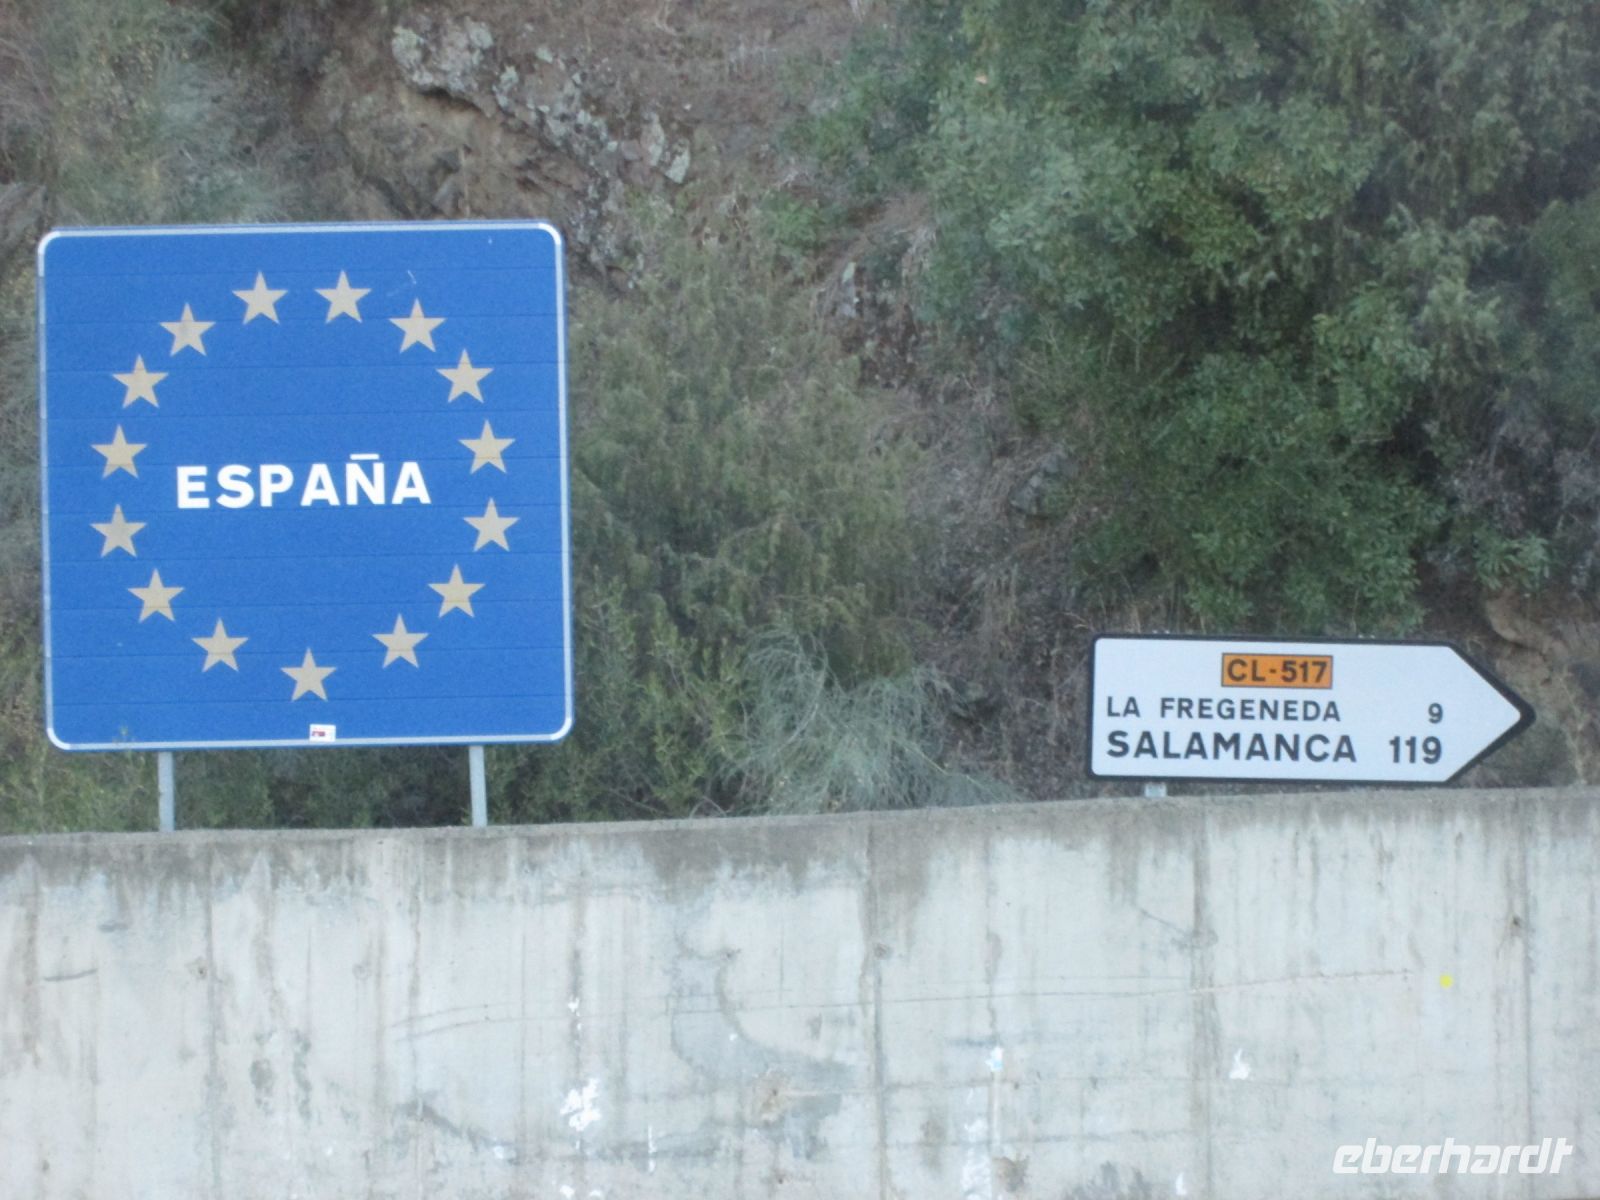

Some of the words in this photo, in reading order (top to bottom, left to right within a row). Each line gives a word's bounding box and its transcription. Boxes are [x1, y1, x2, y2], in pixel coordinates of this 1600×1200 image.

[176, 453, 431, 509] ESPAÑA
[1226, 658, 1328, 684] CL-517
[1106, 696, 1141, 719] LA
[1160, 697, 1341, 723] FREGENEDA
[1428, 703, 1444, 724] 9
[1106, 730, 1357, 763] SALAMANCA
[1388, 735, 1442, 765] 119
